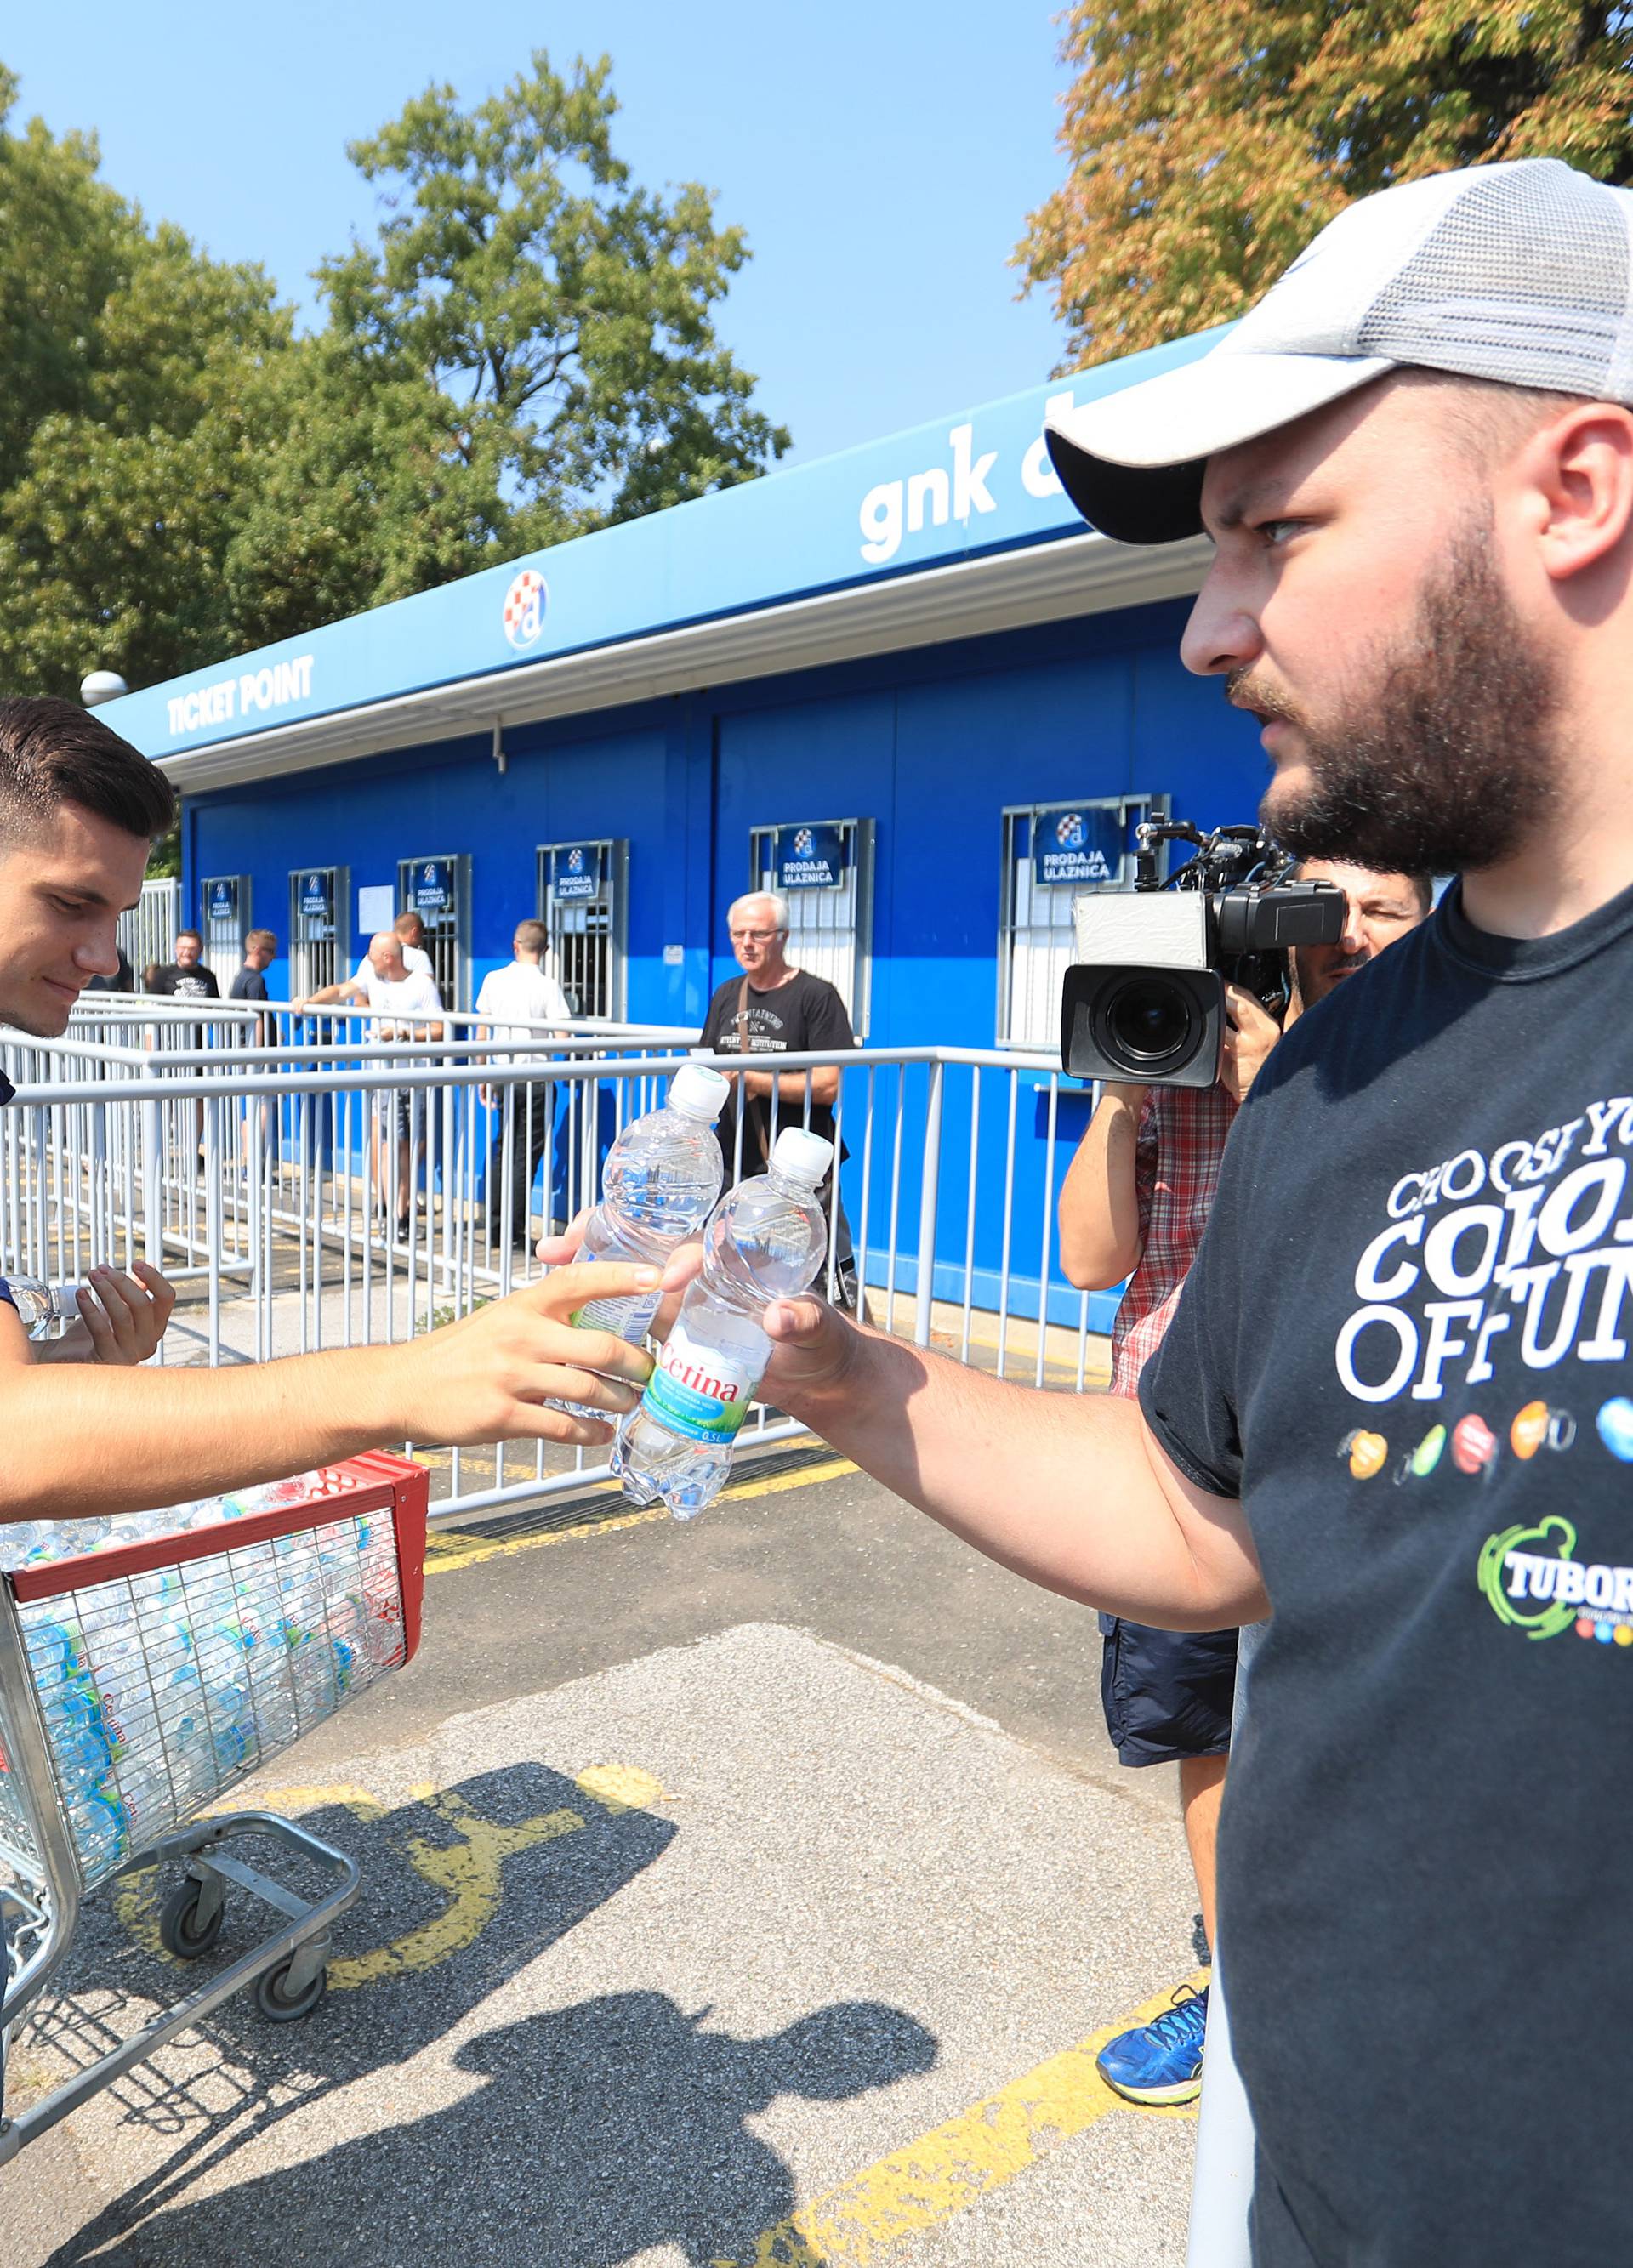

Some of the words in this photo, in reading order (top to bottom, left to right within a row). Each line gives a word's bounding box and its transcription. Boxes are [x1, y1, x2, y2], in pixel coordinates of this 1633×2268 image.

[859, 423, 998, 565] gnk
[167, 679, 236, 735] TICKET
[239, 654, 315, 715] POINT
[783, 861, 830, 873] PRODAJA
[1044, 850, 1106, 867] PRODAJA
[559, 876, 592, 886] PRODAJA
[783, 872, 834, 884] ULAZNICA
[1044, 864, 1110, 881] ULAZNICA
[417, 887, 444, 896] PRODAJA
[559, 885, 594, 895] ULAZNICA
[1355, 1157, 1633, 1301] COLO
[1335, 1299, 1484, 1403] OF
[660, 1342, 739, 1403] Cetina
[701, 1430, 722, 1443] 0,5L
